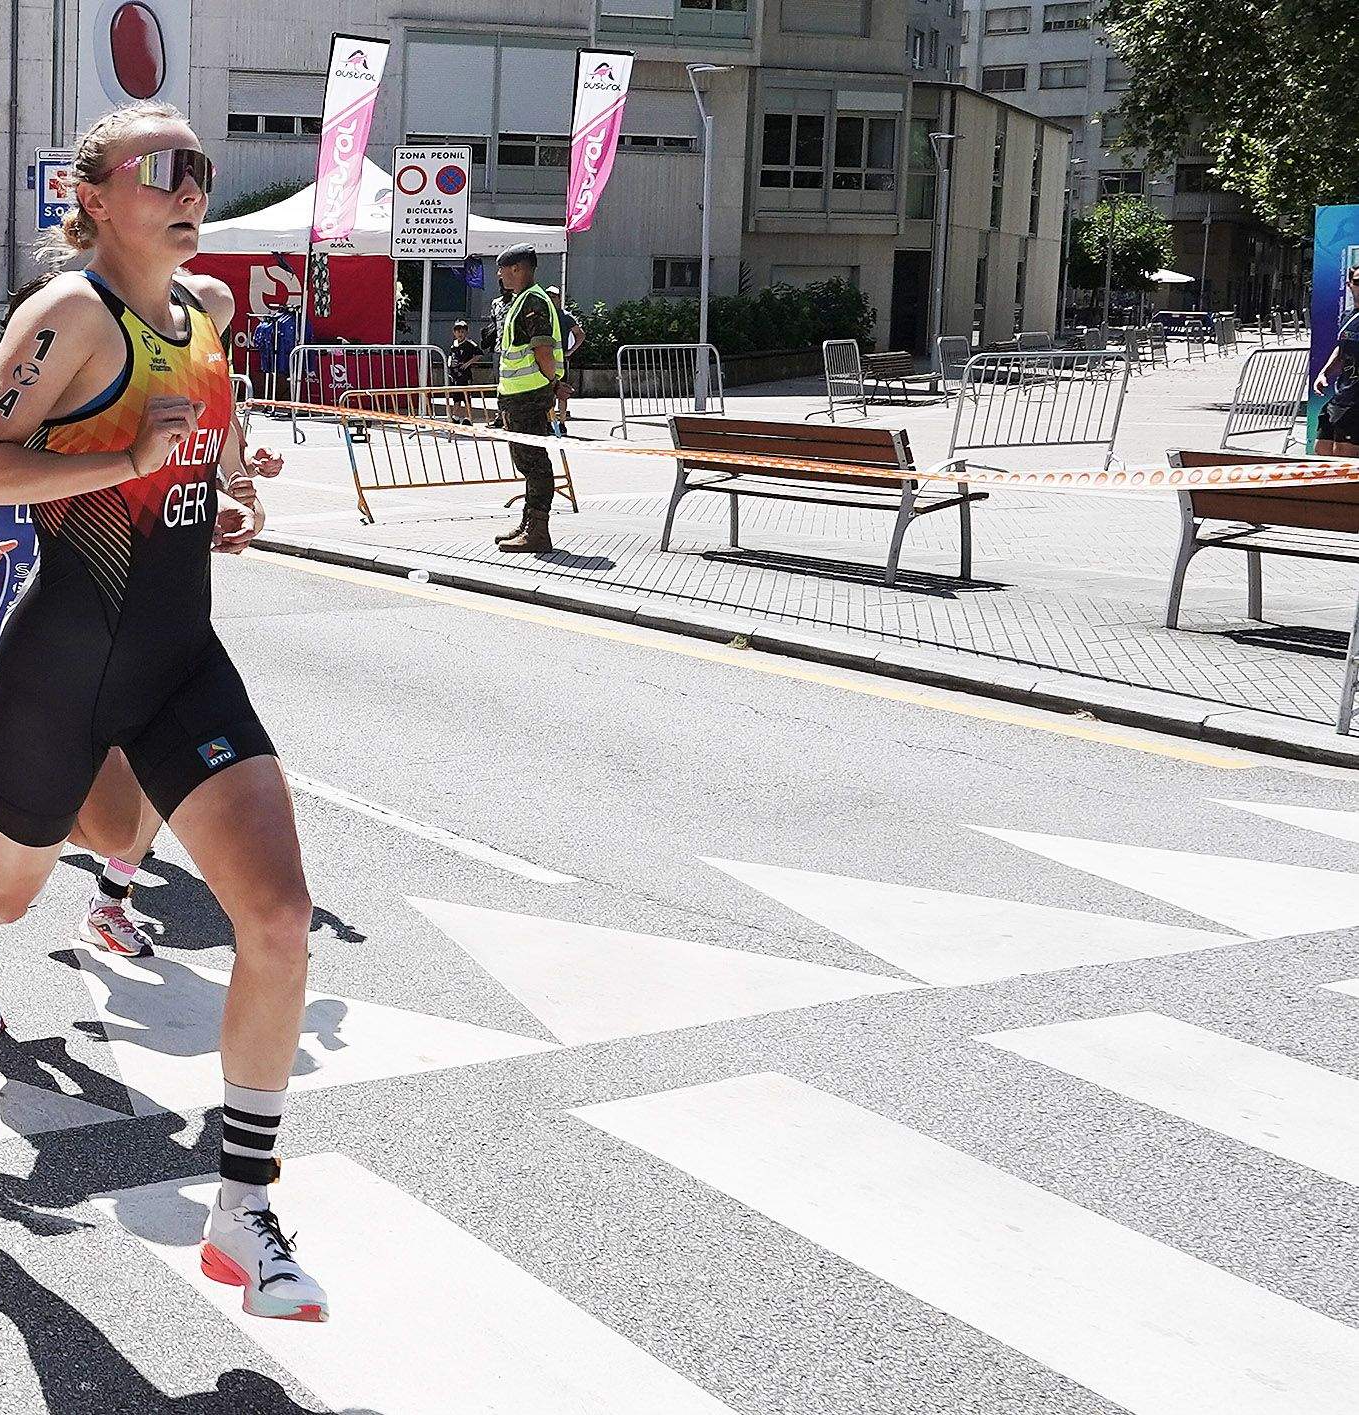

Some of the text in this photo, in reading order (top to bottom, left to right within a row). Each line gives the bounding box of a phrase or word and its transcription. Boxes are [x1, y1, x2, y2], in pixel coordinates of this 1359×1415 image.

[400, 151, 465, 160] ZONA PEONIL
[406, 207, 454, 215] BICICLETAS
[405, 217, 454, 225] E SERVIZOS
[400, 227, 459, 236] AUTORIZADOS
[395, 237, 464, 245] CRUZ VERMELLA
[33, 328, 58, 363] 1
[163, 481, 209, 528] GER
[209, 751, 233, 766] DTU
